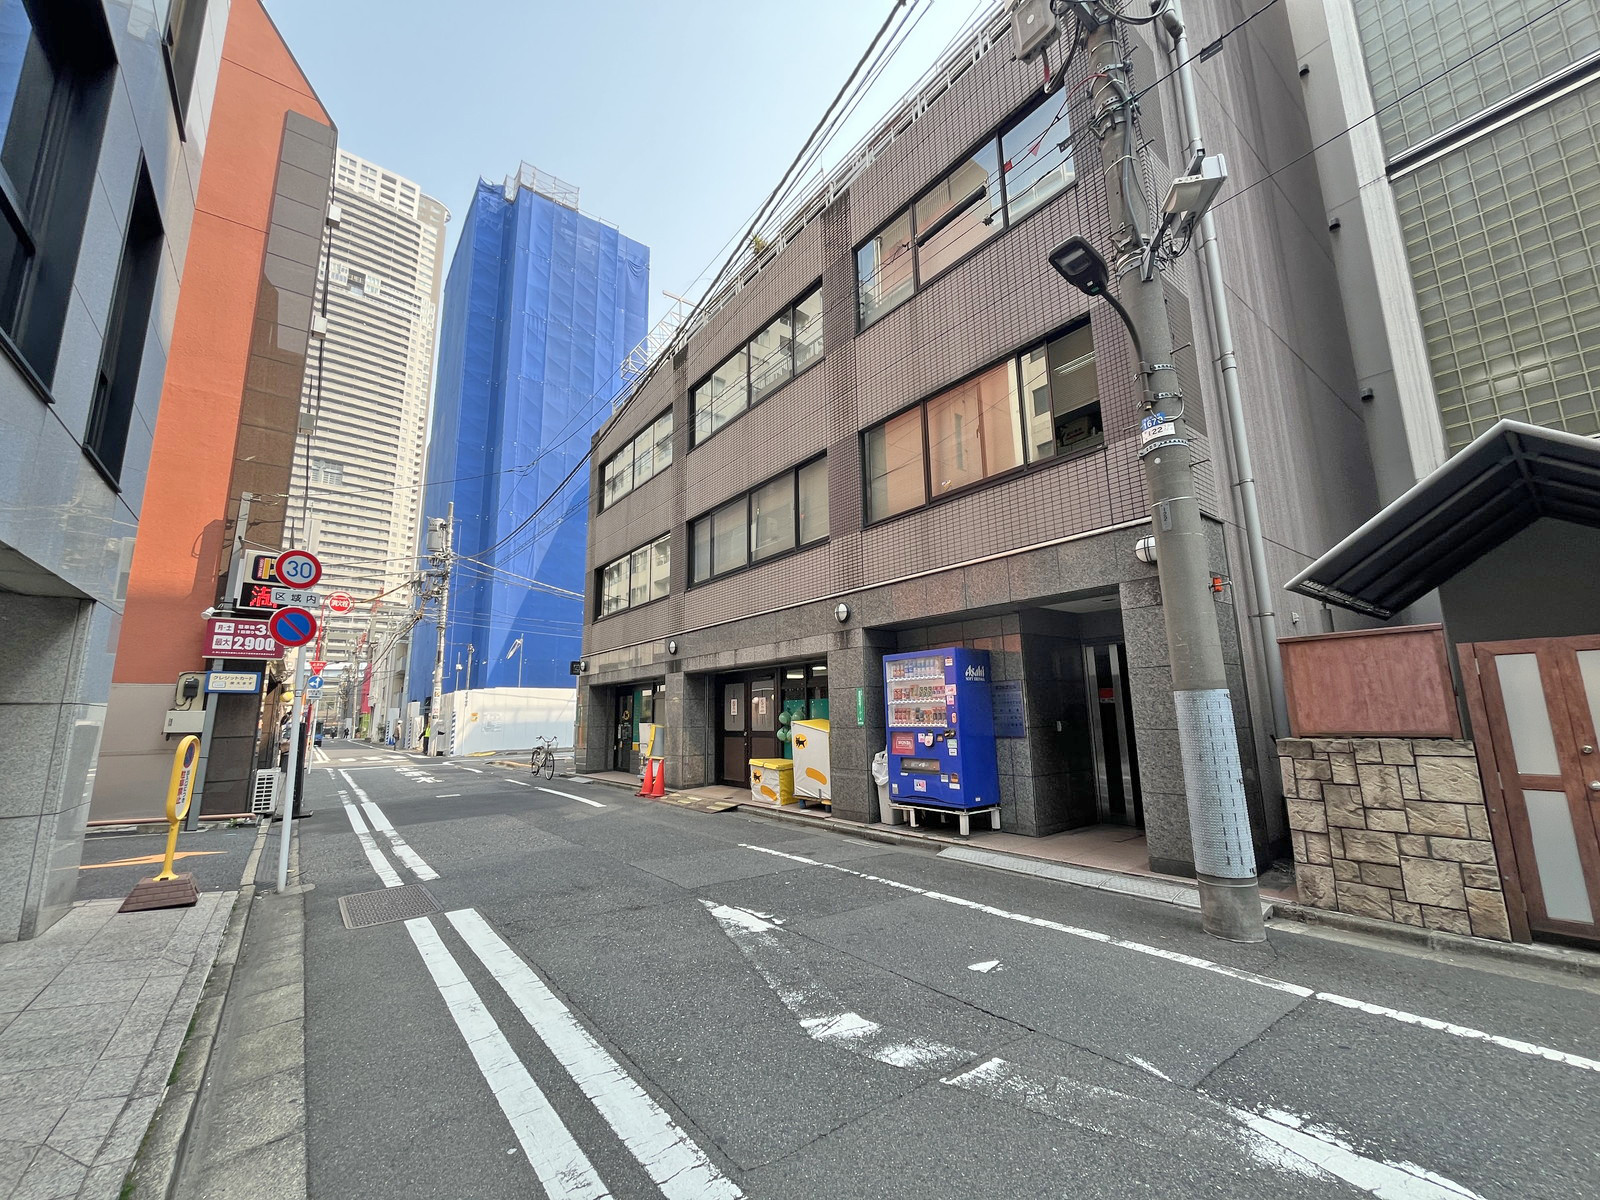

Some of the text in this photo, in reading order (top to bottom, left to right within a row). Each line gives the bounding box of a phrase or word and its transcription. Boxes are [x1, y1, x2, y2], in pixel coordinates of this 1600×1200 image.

[286, 560, 312, 579] 30
[275, 592, 316, 604] 区域内
[965, 664, 985, 677] Asahi
